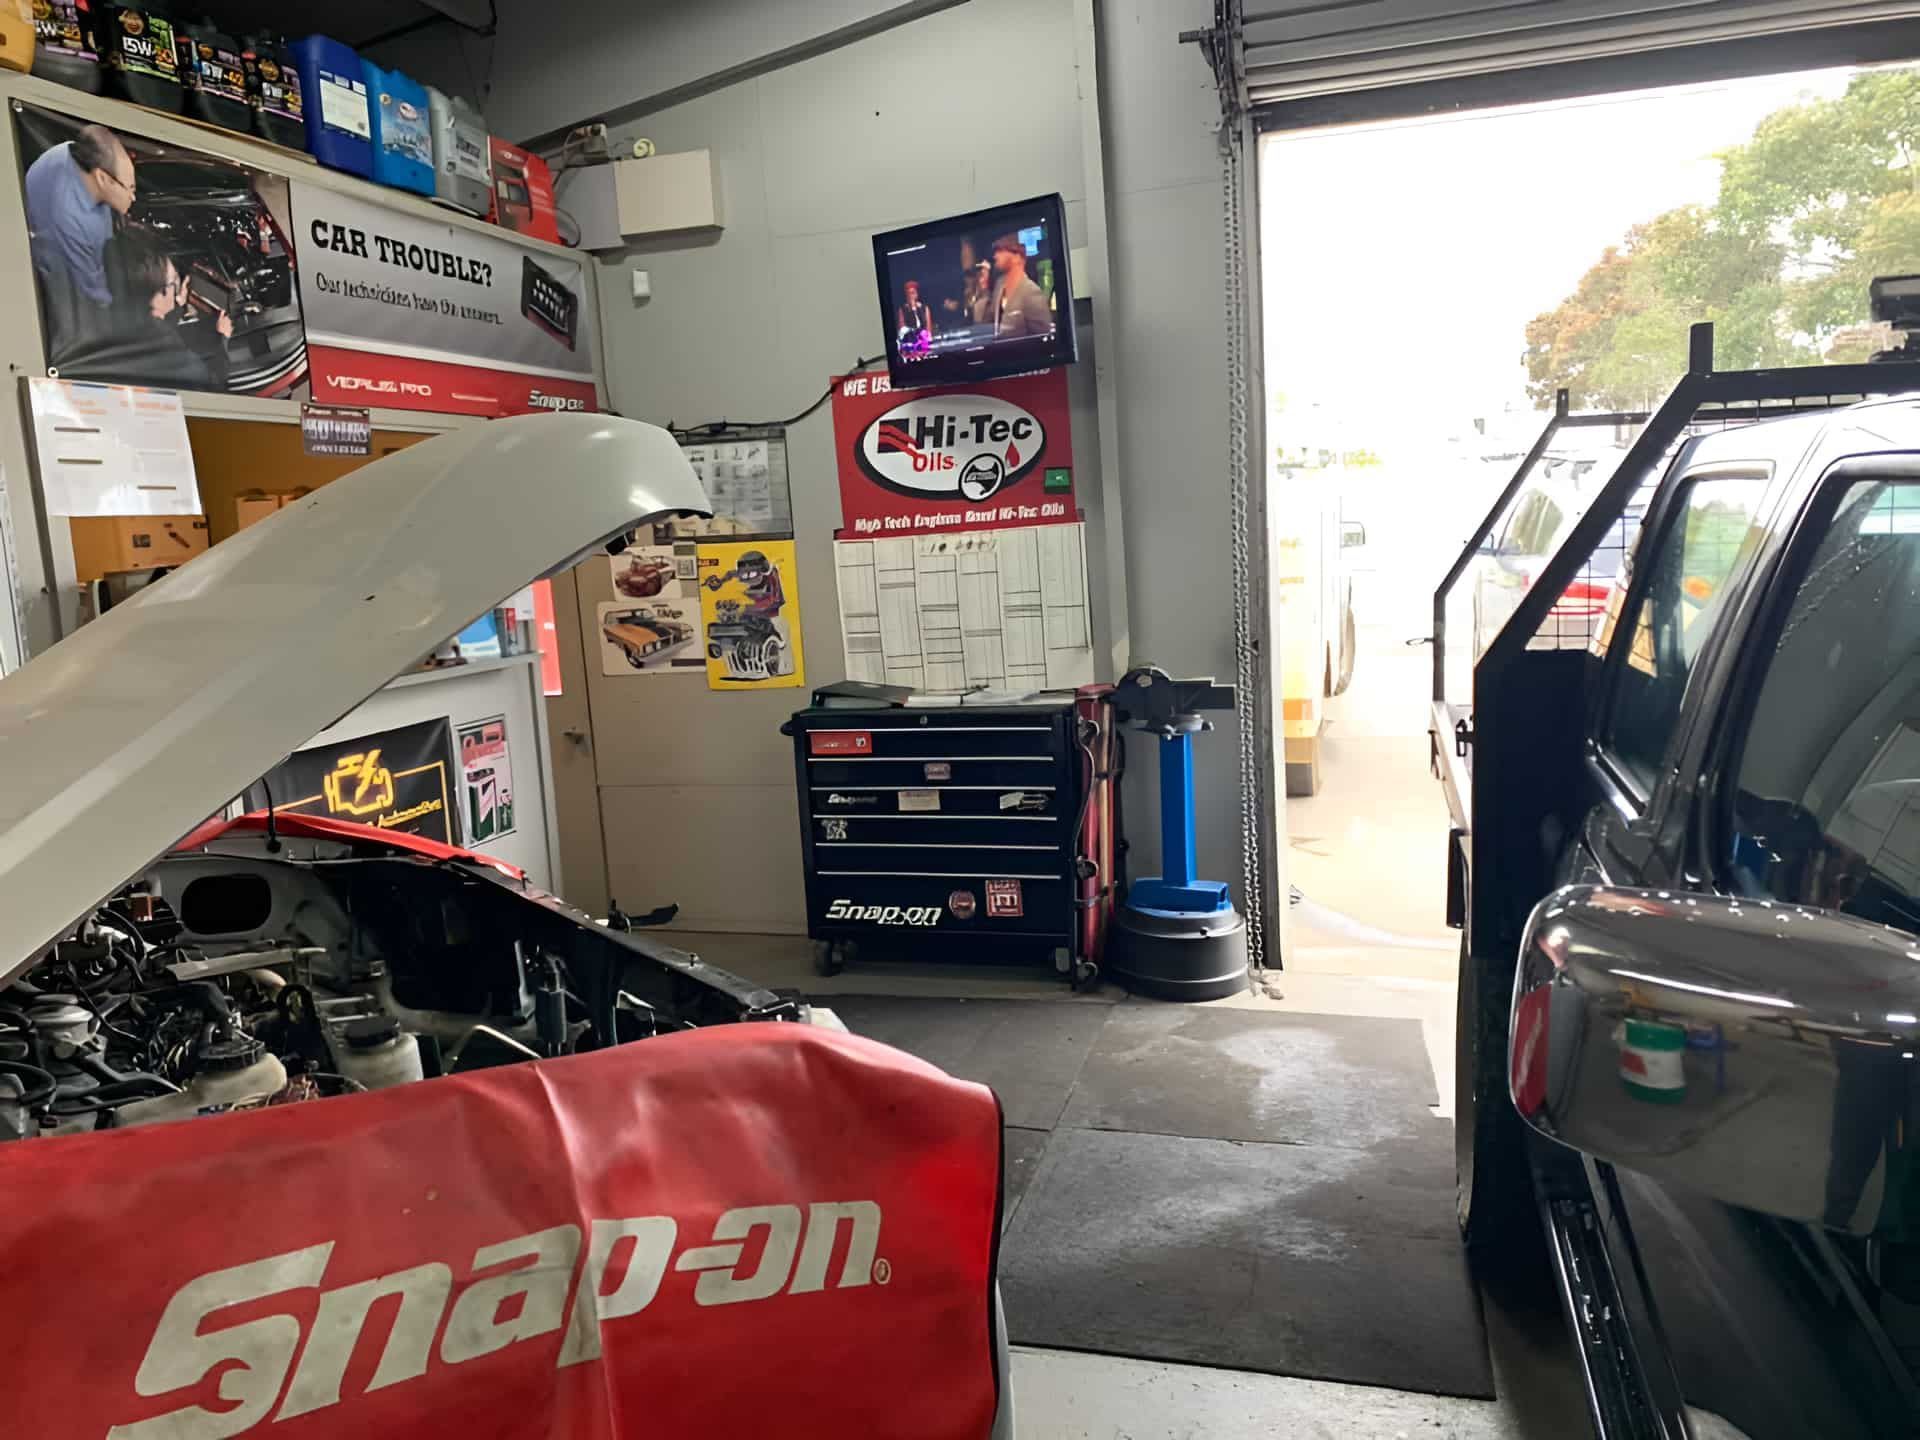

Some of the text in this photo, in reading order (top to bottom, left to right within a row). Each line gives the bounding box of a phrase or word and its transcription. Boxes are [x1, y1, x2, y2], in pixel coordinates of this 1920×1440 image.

[311, 219, 492, 287] CAR TROUBLE?
[316, 271, 341, 294] Our
[843, 378, 867, 397] WE
[872, 375, 892, 394] US
[916, 414, 1033, 449] Hi-Tec
[913, 452, 955, 473] Oils
[884, 515, 911, 529] Tech
[999, 505, 1038, 520] Hi-Tec
[1041, 502, 1065, 516] Oils
[826, 899, 943, 926] Snap-on
[106, 1200, 881, 1440] Snap-on
